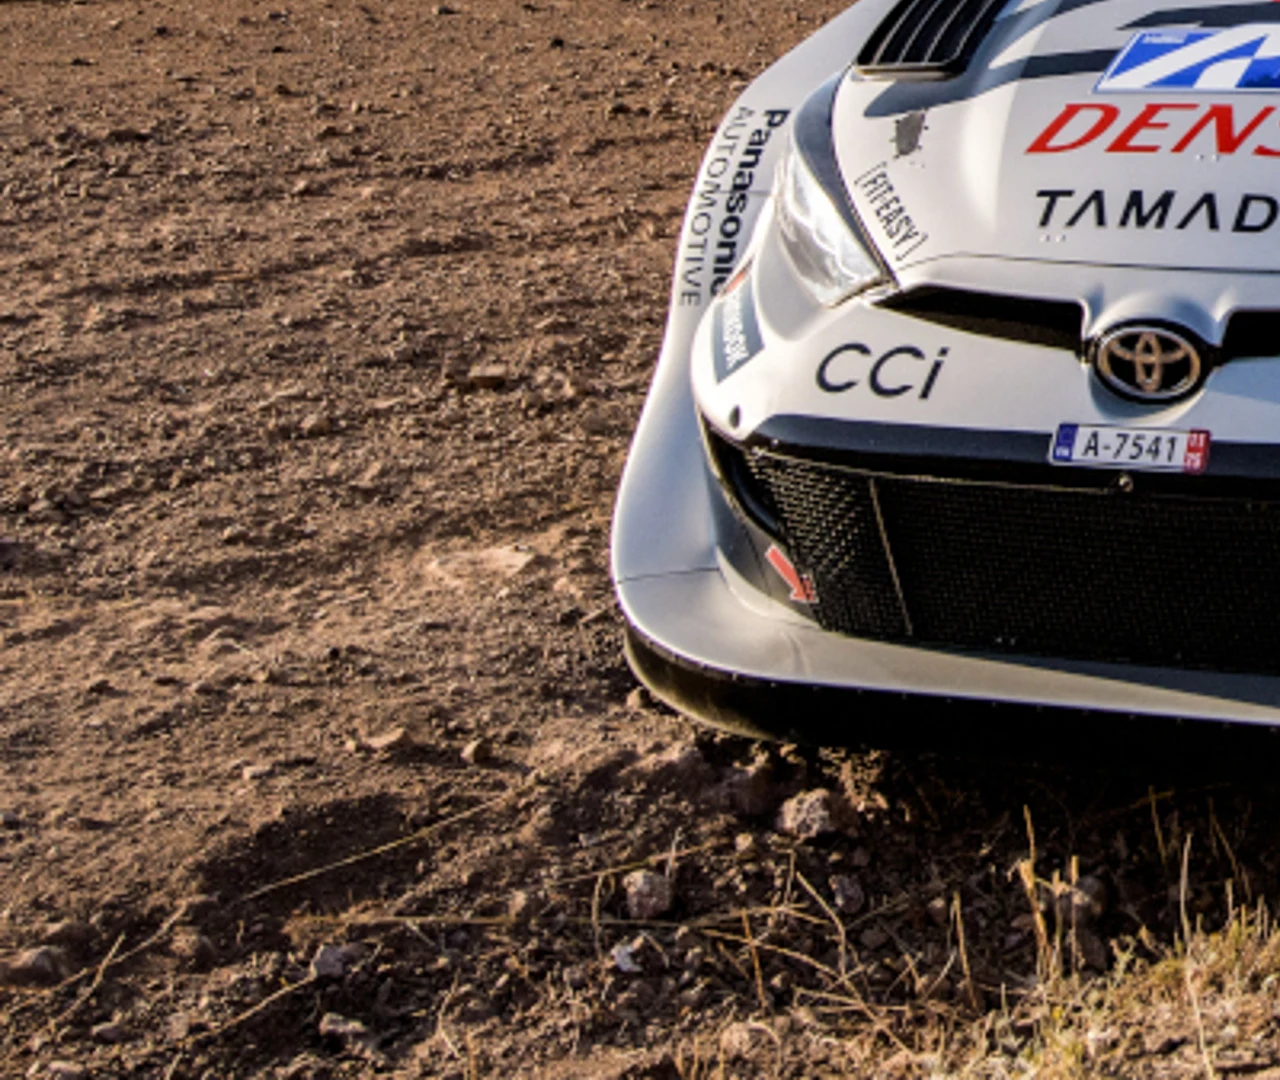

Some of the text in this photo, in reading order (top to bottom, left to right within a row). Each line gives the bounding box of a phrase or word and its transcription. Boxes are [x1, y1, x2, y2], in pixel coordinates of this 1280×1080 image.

[679, 106, 754, 306] AUTOMOTIVE
[710, 109, 790, 298] Panasonic
[816, 342, 951, 400] CCi
[1082, 431, 1177, 462] A-7541
